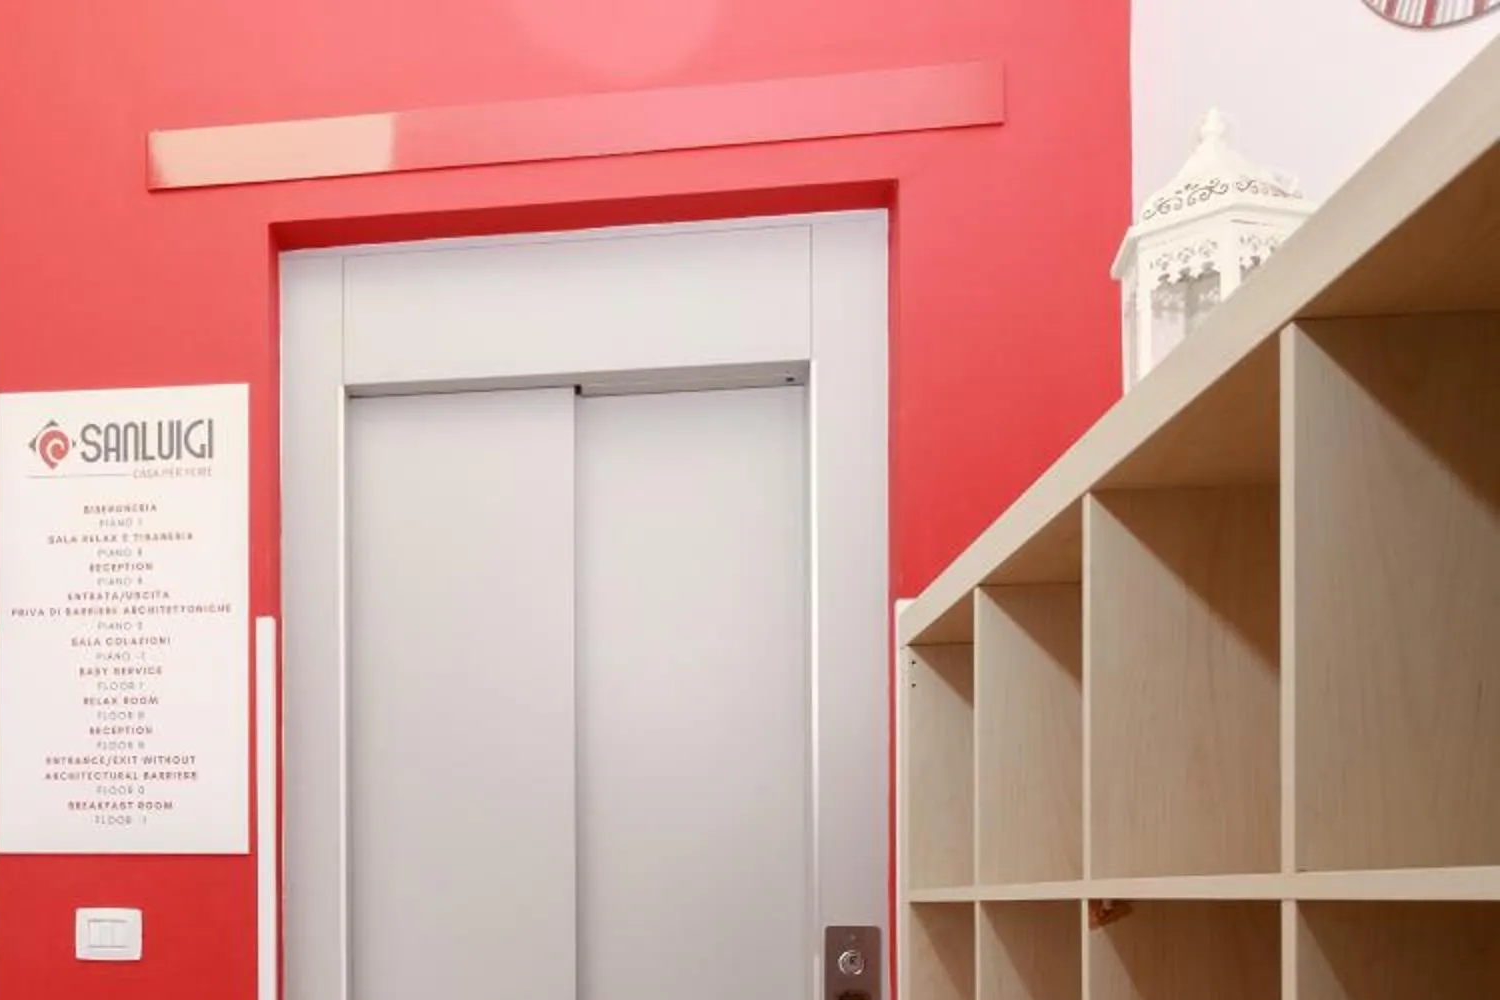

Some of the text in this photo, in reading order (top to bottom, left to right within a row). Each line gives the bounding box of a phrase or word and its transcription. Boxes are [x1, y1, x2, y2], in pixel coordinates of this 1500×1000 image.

[80, 418, 214, 463] SANLUIGI
[99, 517, 133, 528] PIANO
[48, 535, 77, 545] SALA
[82, 533, 117, 543] RELAX
[122, 533, 128, 542] E
[97, 547, 132, 558] PIANO
[89, 562, 154, 573] RECEPTION
[97, 577, 132, 586] PIANO
[67, 590, 170, 602] ENTRATA/USCITA
[11, 607, 44, 617] PRIVA
[49, 607, 61, 617] DI
[123, 603, 231, 615] ARCHITETTONICHE
[97, 621, 132, 631] PIANO
[71, 636, 170, 647] SALA COLAZIONI
[96, 651, 131, 661] PIANO
[79, 666, 162, 676] BABY SERVICE
[97, 681, 134, 691] FLOOR
[83, 696, 159, 705] RELAX ROOM
[97, 711, 133, 720] FLOOR
[89, 726, 153, 735] RECEPTION
[97, 740, 133, 750] FLOOR
[45, 755, 196, 766] ENTRANCE/EXIT WITHOUT
[45, 771, 138, 781] ARCHITECTURAL
[96, 785, 133, 795] FLOOR
[67, 800, 173, 810] BREAKFAST ROOM
[94, 815, 131, 825] FLOOR
